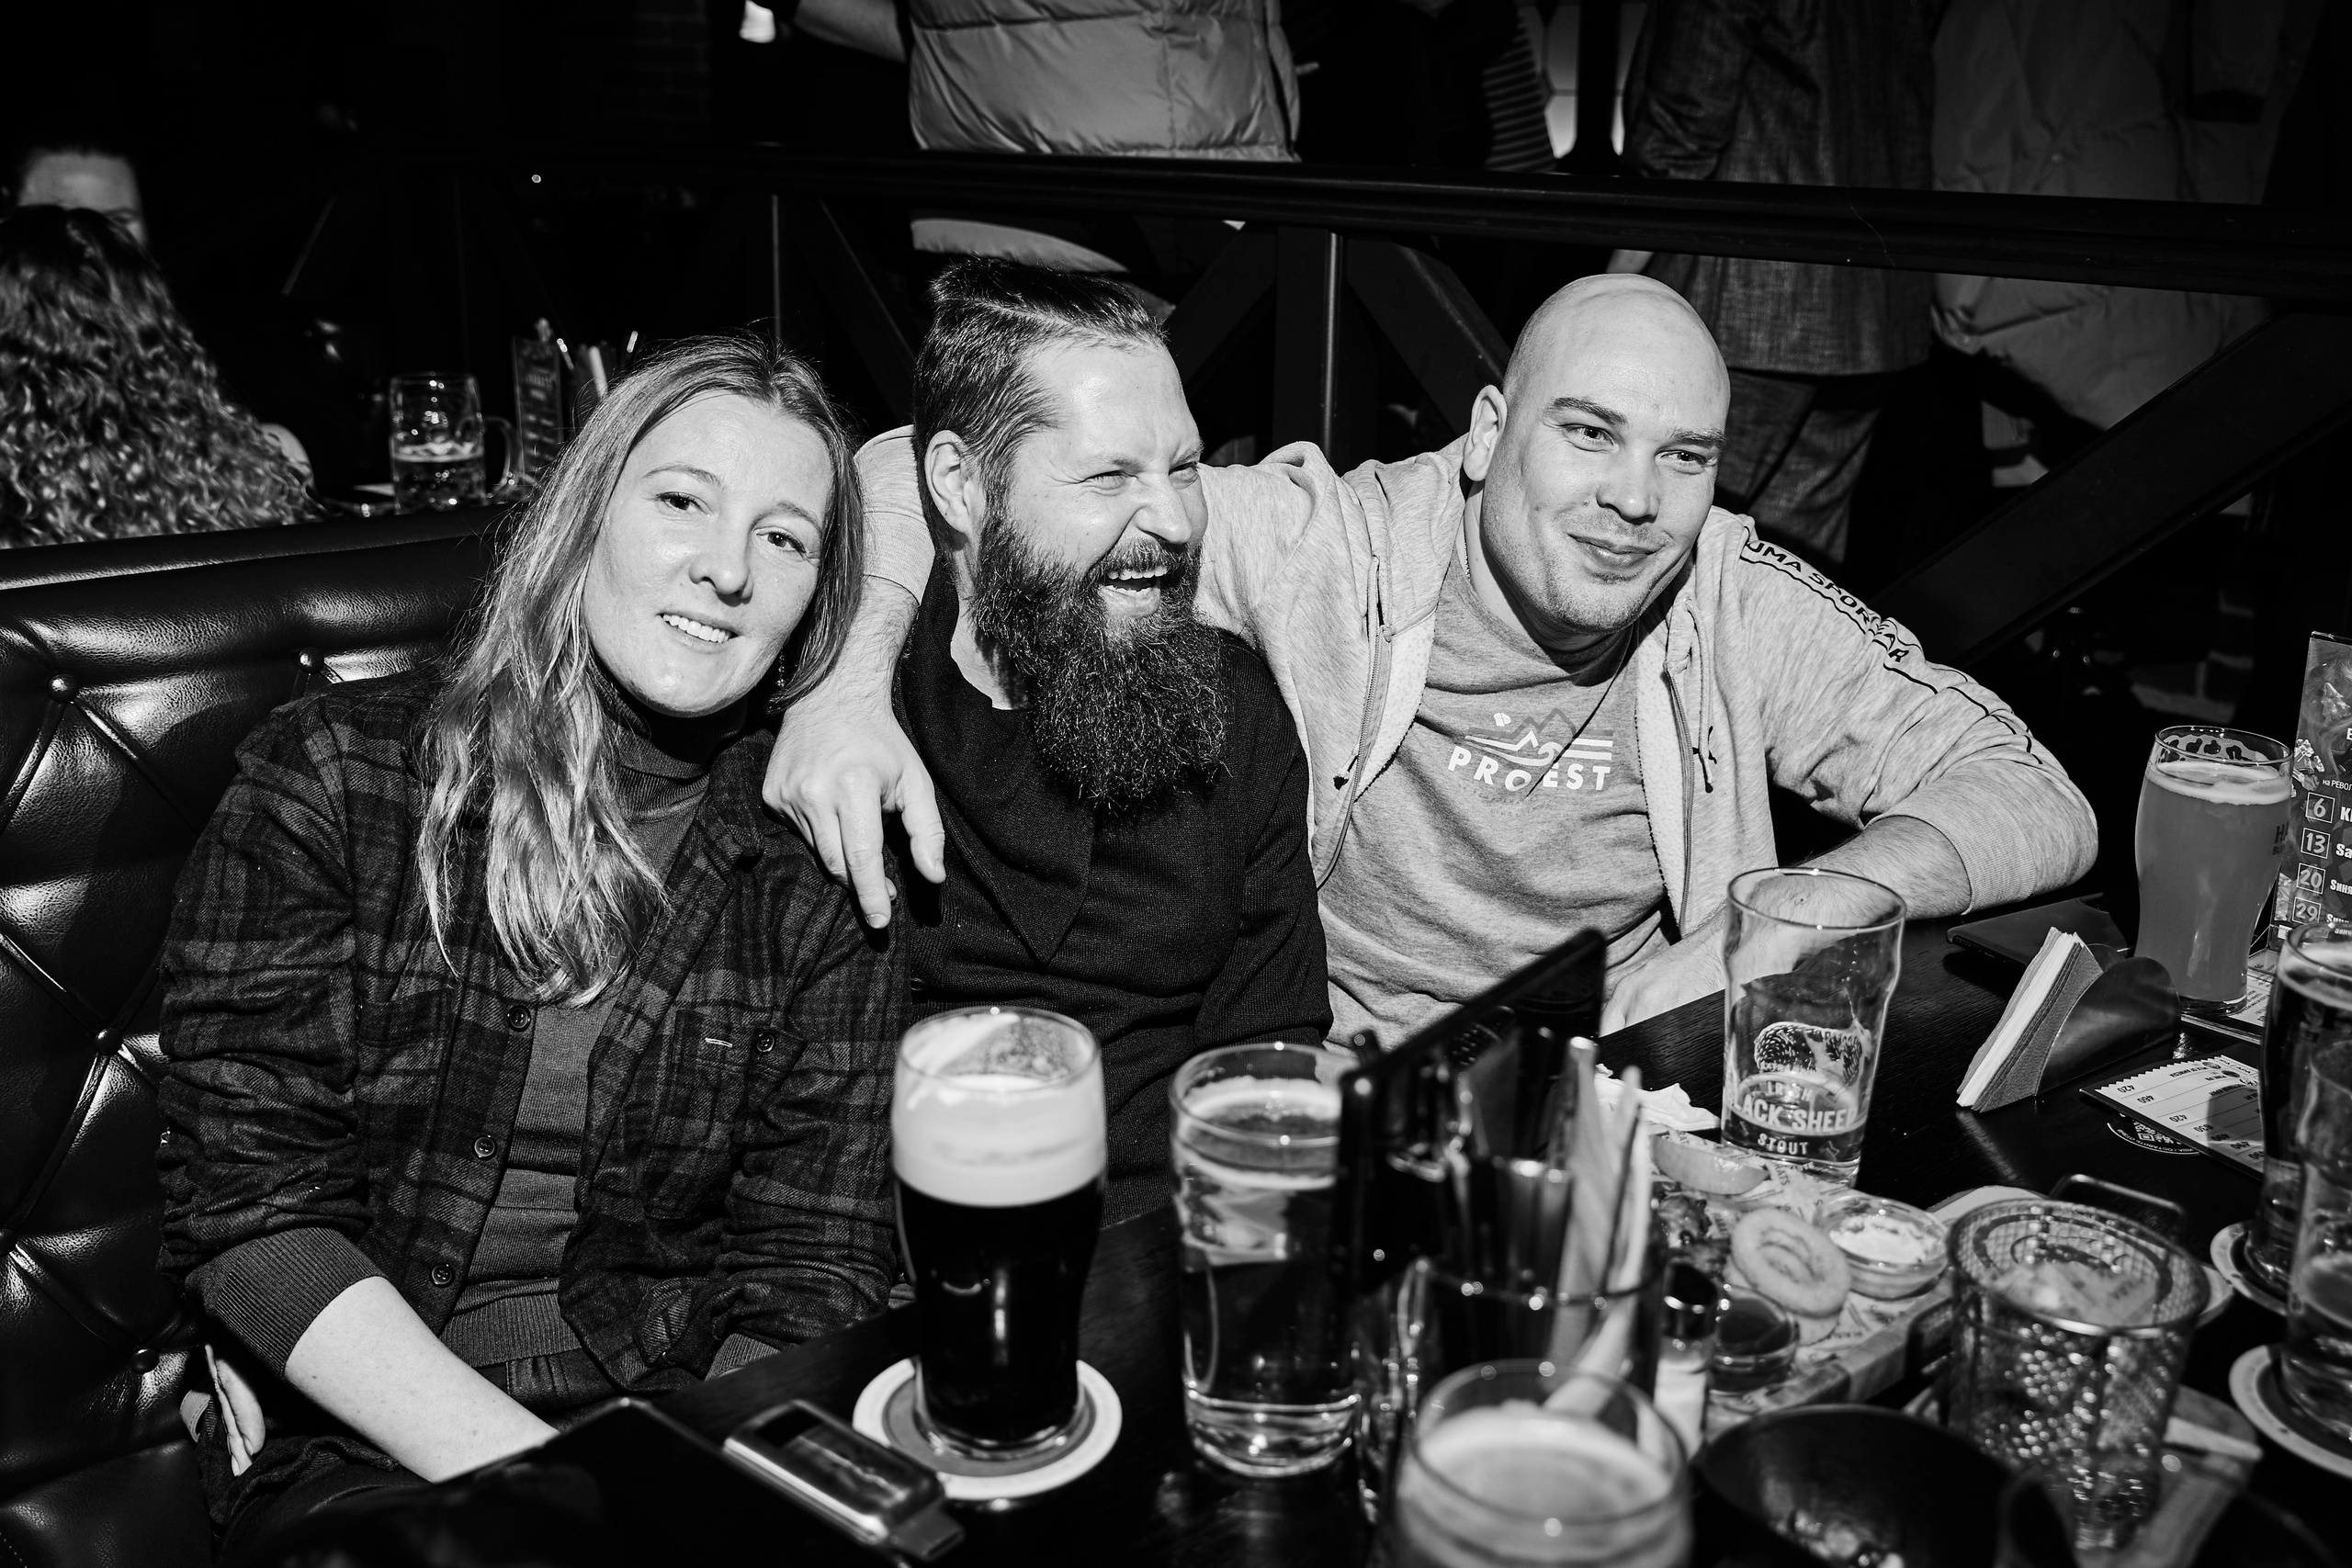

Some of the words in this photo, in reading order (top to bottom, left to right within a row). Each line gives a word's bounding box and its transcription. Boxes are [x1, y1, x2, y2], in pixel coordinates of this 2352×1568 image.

[2313, 797, 2326, 818] 6
[2306, 832, 2326, 854] 13
[2300, 869, 2323, 888] 20
[2296, 903, 2318, 922] 29
[1758, 1133, 1808, 1156] STOUT
